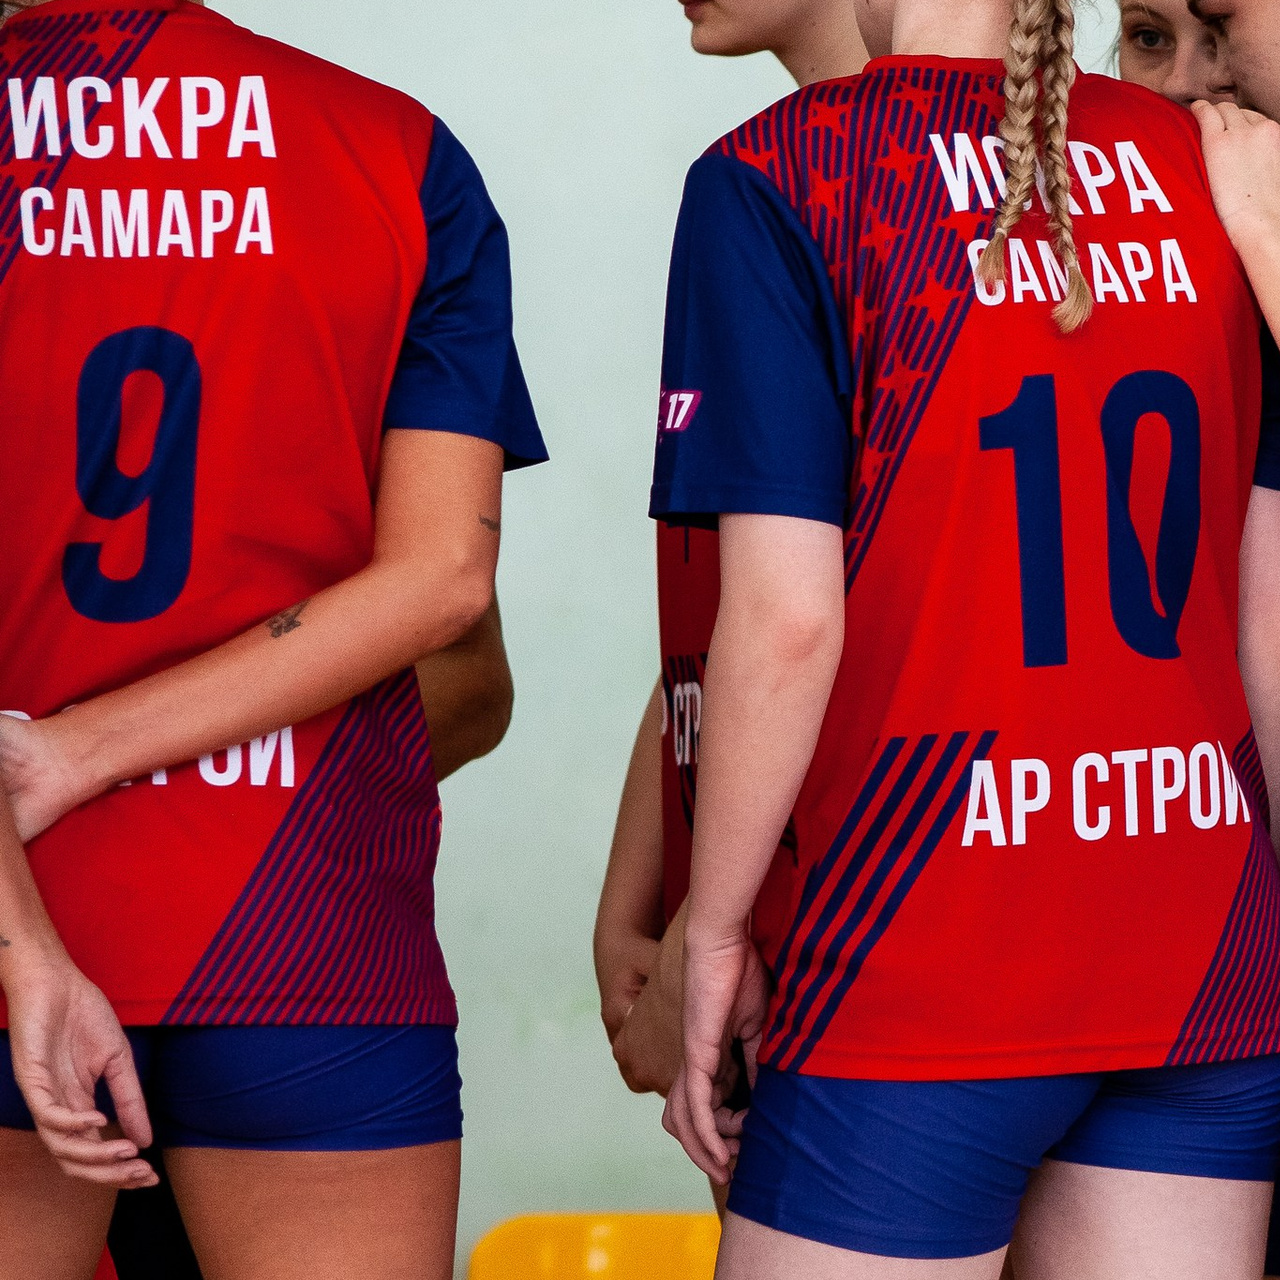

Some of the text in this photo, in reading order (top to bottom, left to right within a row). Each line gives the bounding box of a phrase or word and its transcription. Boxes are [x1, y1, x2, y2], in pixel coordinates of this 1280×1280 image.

[8, 76, 277, 160] ИСКРА
[20, 186, 274, 258] САМАРА
[665, 393, 695, 429] 17
[61, 325, 200, 624] 9
[979, 369, 1201, 668] 10
[961, 758, 1051, 847] АР
